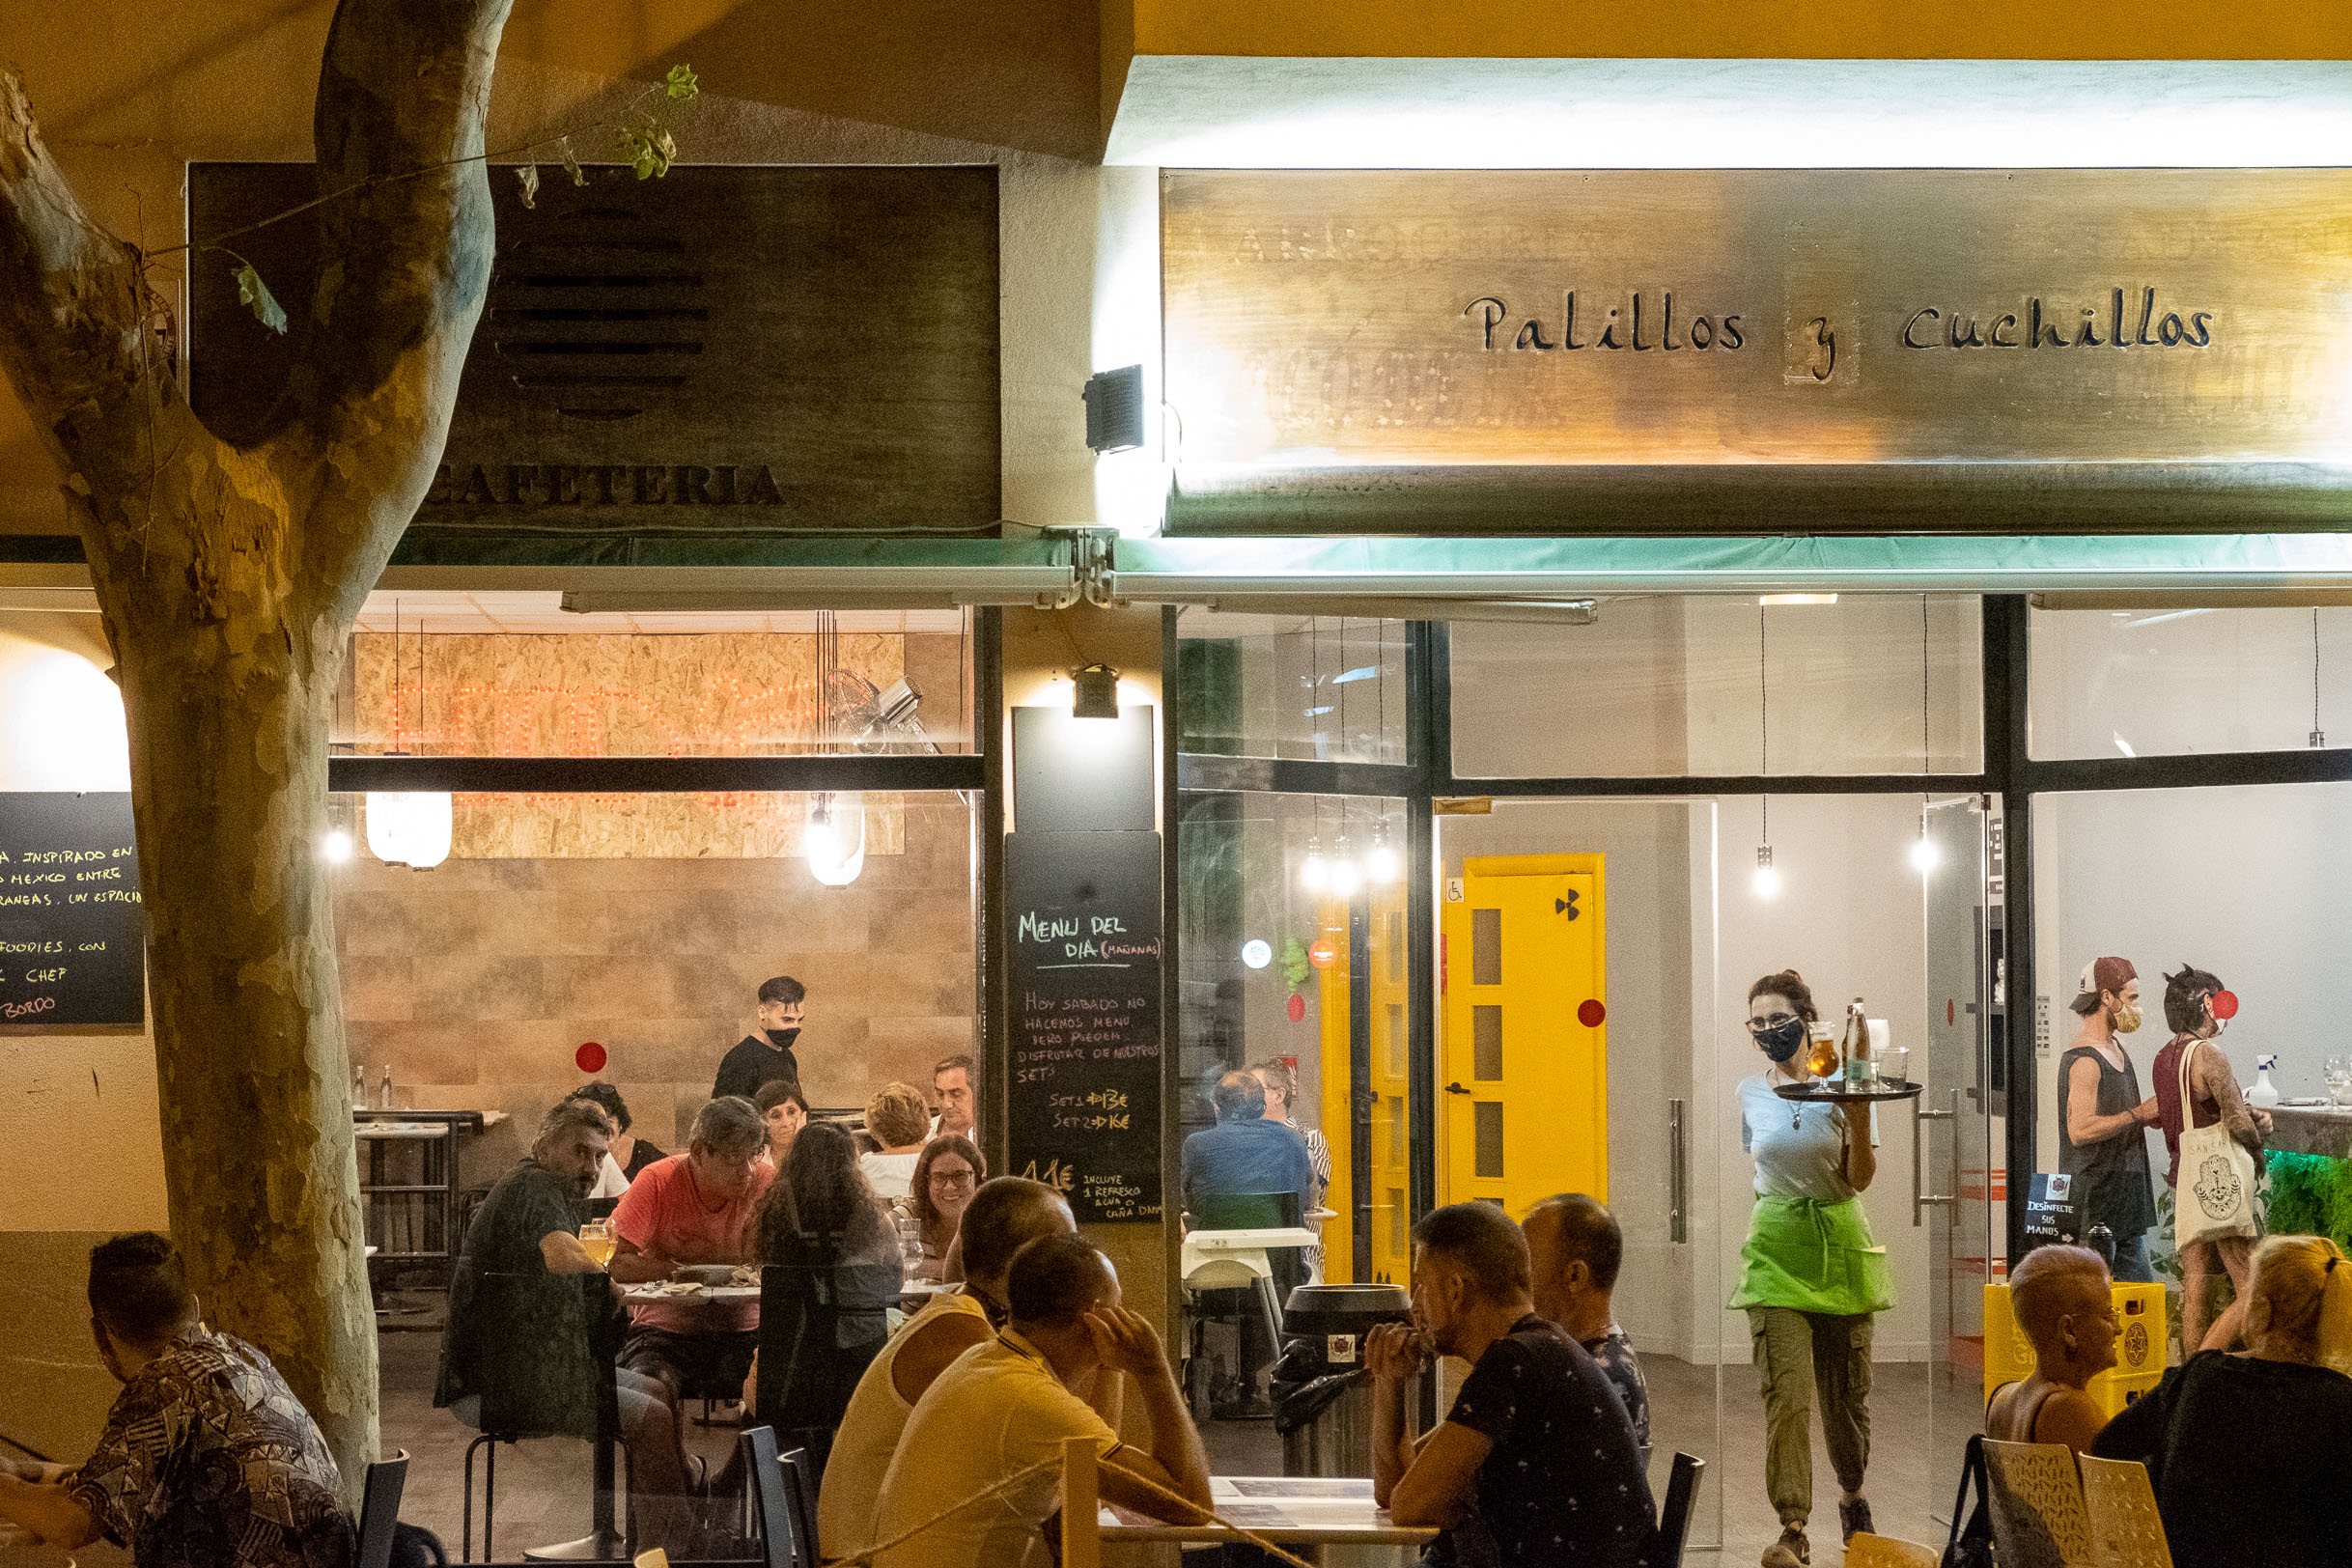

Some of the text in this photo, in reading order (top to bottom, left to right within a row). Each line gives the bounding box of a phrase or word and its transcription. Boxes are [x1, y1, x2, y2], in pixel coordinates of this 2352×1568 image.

[1465, 286, 2213, 379] Palillos y Cuchillos
[22, 851, 106, 863] INSPIRADO
[112, 846, 132, 857] EN
[11, 873, 66, 884] MEXICO
[76, 867, 121, 881] ENTRE
[1019, 911, 1128, 942] MENU DEL
[78, 941, 105, 951] CON
[1065, 939, 1099, 959] DIA
[26, 967, 68, 982] CHEF
[1062, 998, 1119, 1011] SABADO
[1127, 997, 1146, 1009] NO
[1025, 1018, 1083, 1030] HACEMOS
[1017, 1049, 1084, 1062] DISFRUTAR
[1093, 1049, 1110, 1058] DE
[1083, 1175, 1122, 1185] INCLUYE
[1082, 1187, 1141, 1197] 1 REFRESCO
[1106, 1207, 1134, 1218] CAÑA
[2041, 1215, 2056, 1224] SUS
[2026, 1224, 2059, 1236] MANOS
